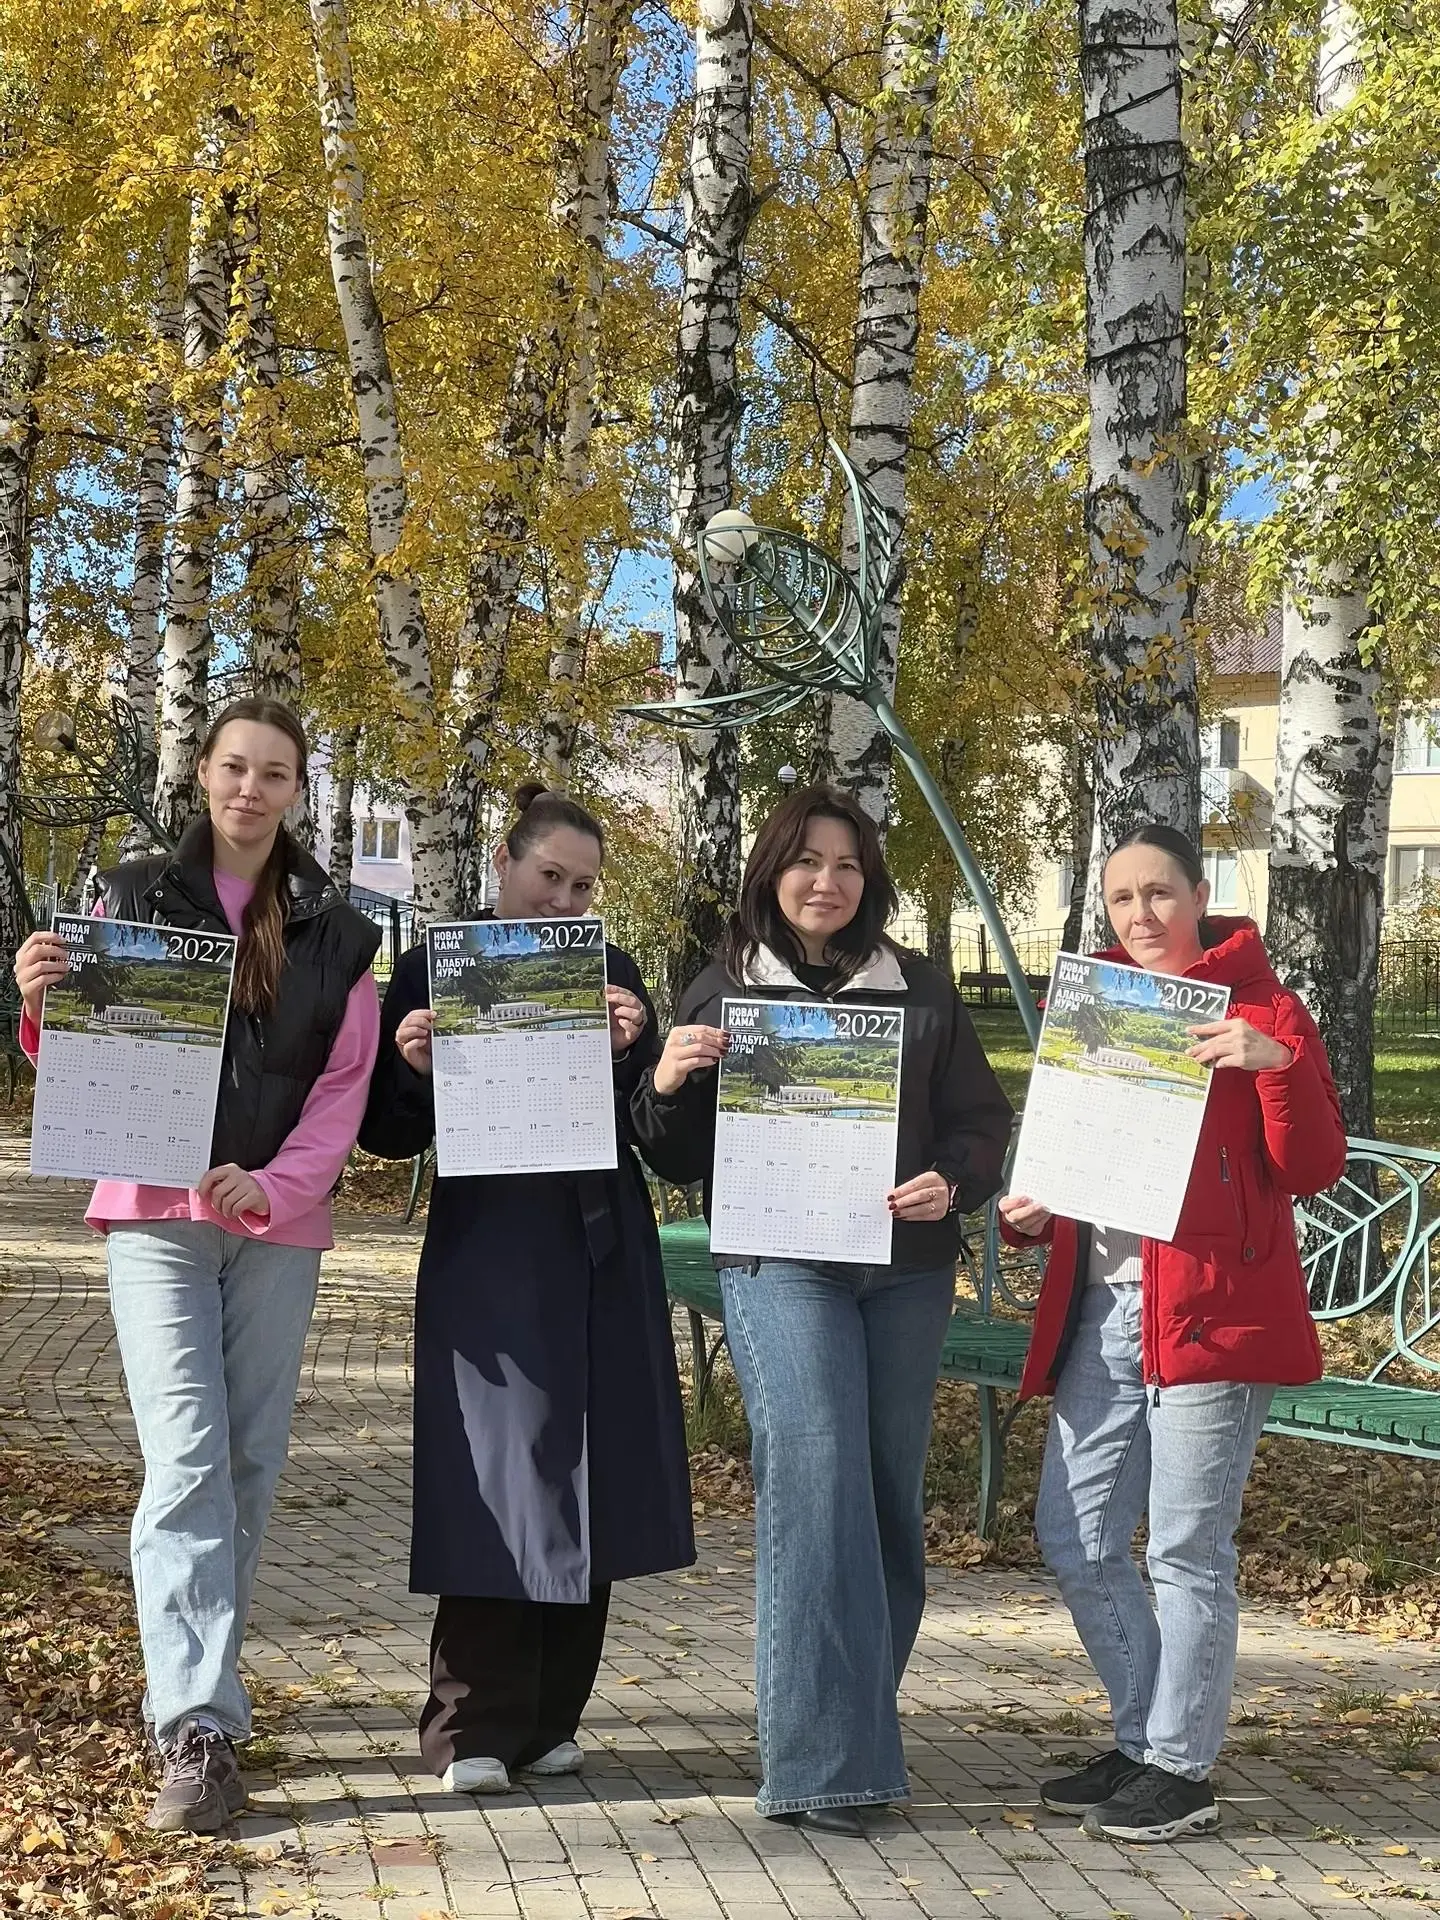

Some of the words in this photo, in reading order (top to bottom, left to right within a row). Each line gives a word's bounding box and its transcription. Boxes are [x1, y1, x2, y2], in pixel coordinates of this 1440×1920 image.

[59, 922, 90, 934] НОВАЯ
[434, 931, 463, 941] НОВАЯ
[540, 925, 599, 949] 2027
[168, 935, 231, 963] 2027
[435, 940, 460, 950] КАМА
[436, 957, 476, 968] АЛАБУГА
[437, 967, 462, 977] НУРЫ
[1060, 961, 1090, 976] НОВАЯ
[1059, 971, 1084, 984] КАМА
[1055, 988, 1095, 1005] АЛАБУГА
[1161, 983, 1224, 1015] 2027
[1054, 997, 1080, 1012] НУРЫ
[729, 1007, 759, 1017] НОВАЯ
[729, 1016, 754, 1026] КАМА
[837, 1013, 897, 1038] 2027
[729, 1034, 769, 1045] АЛАБУГА
[729, 1043, 754, 1054] НУРЫ
[726, 1115, 734, 1123] 01
[42, 1124, 51, 1132] 09
[808, 1162, 817, 1170] 07
